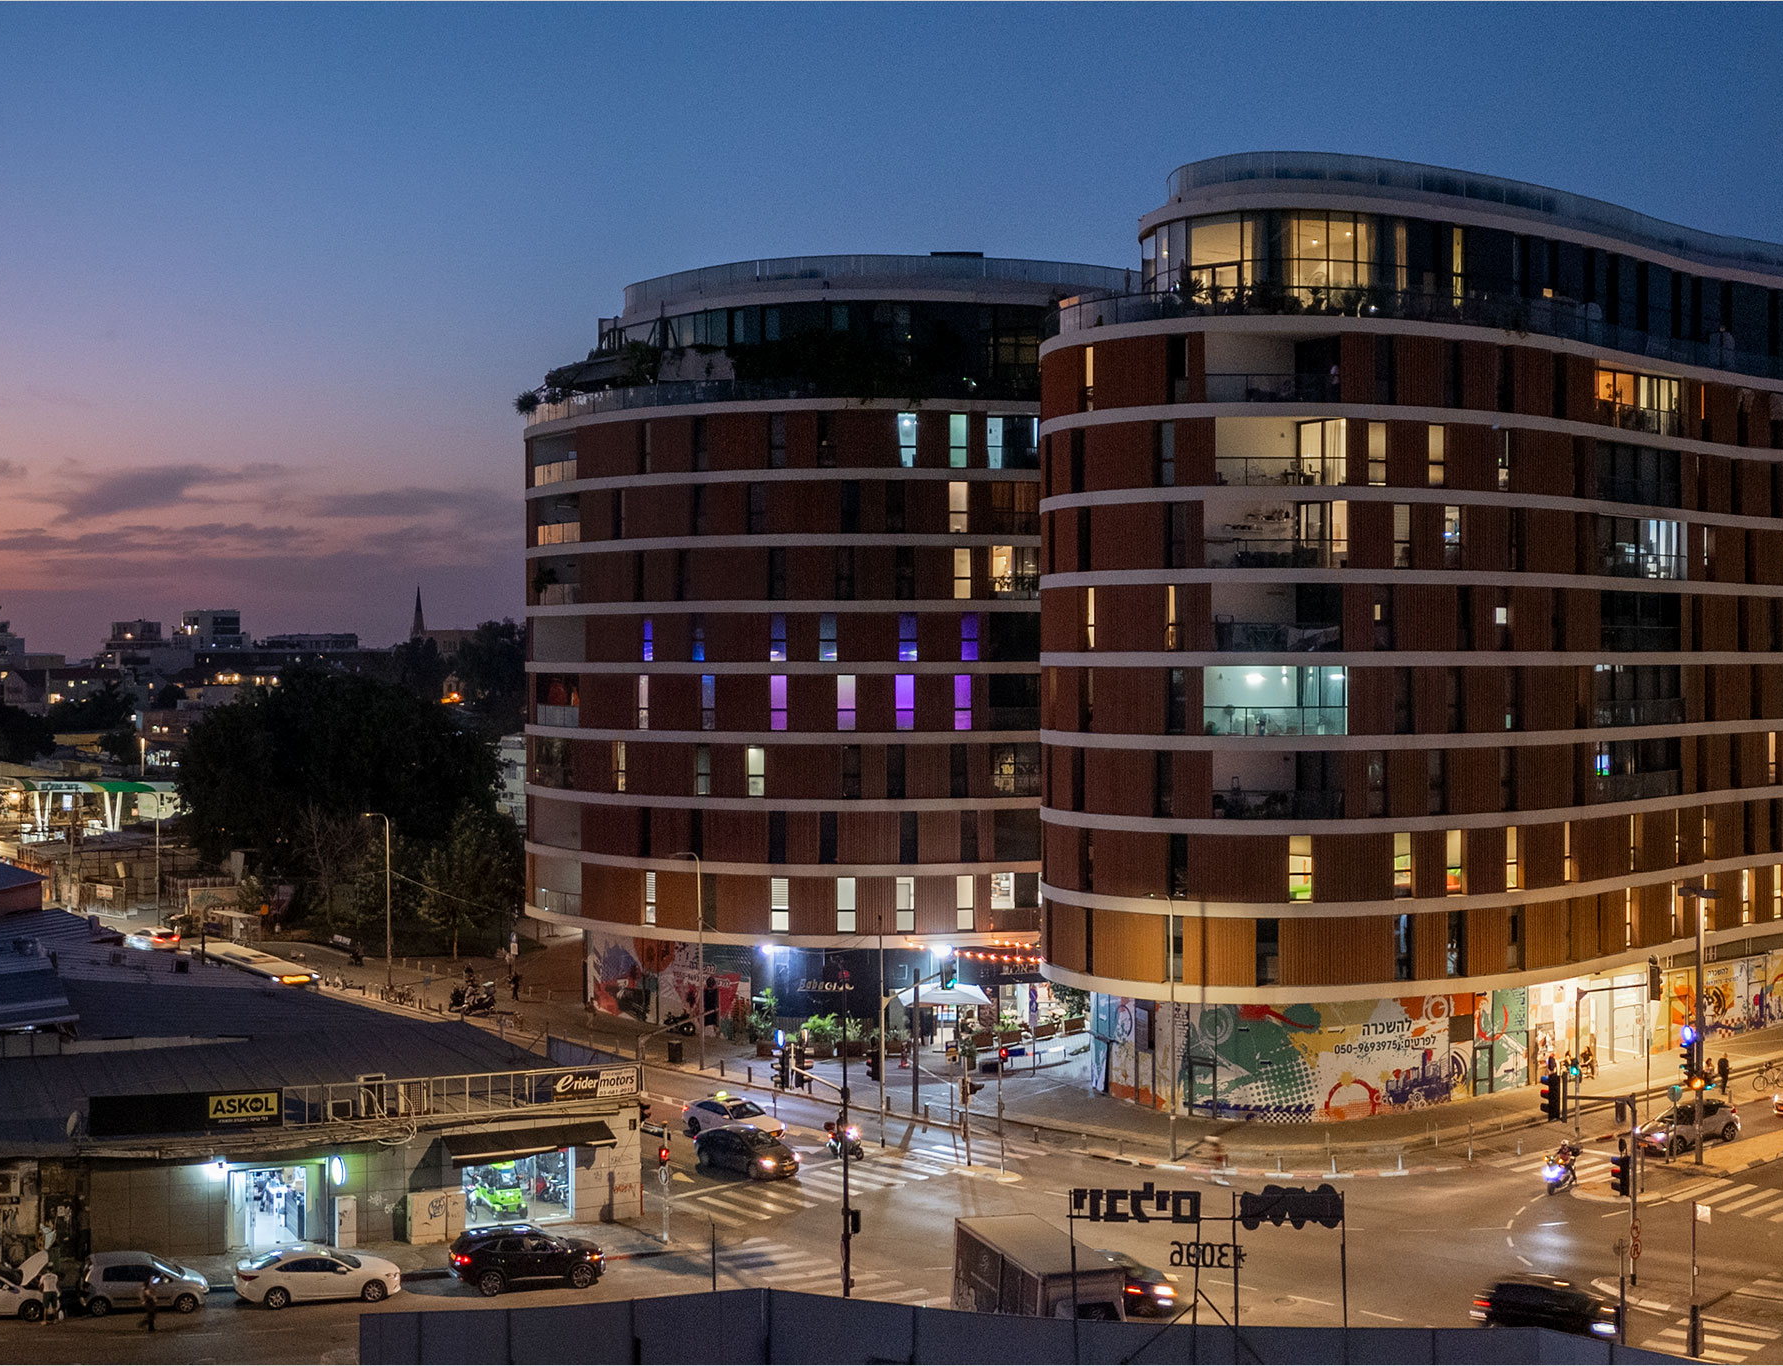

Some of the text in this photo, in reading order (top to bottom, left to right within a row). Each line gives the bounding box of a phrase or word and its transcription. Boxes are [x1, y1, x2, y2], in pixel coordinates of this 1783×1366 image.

[1362, 1018, 1412, 1036] להשכרה
[1334, 1040, 1399, 1054] 050-9693975
[599, 1075, 634, 1088] motors
[213, 1097, 274, 1115] ASKOL
